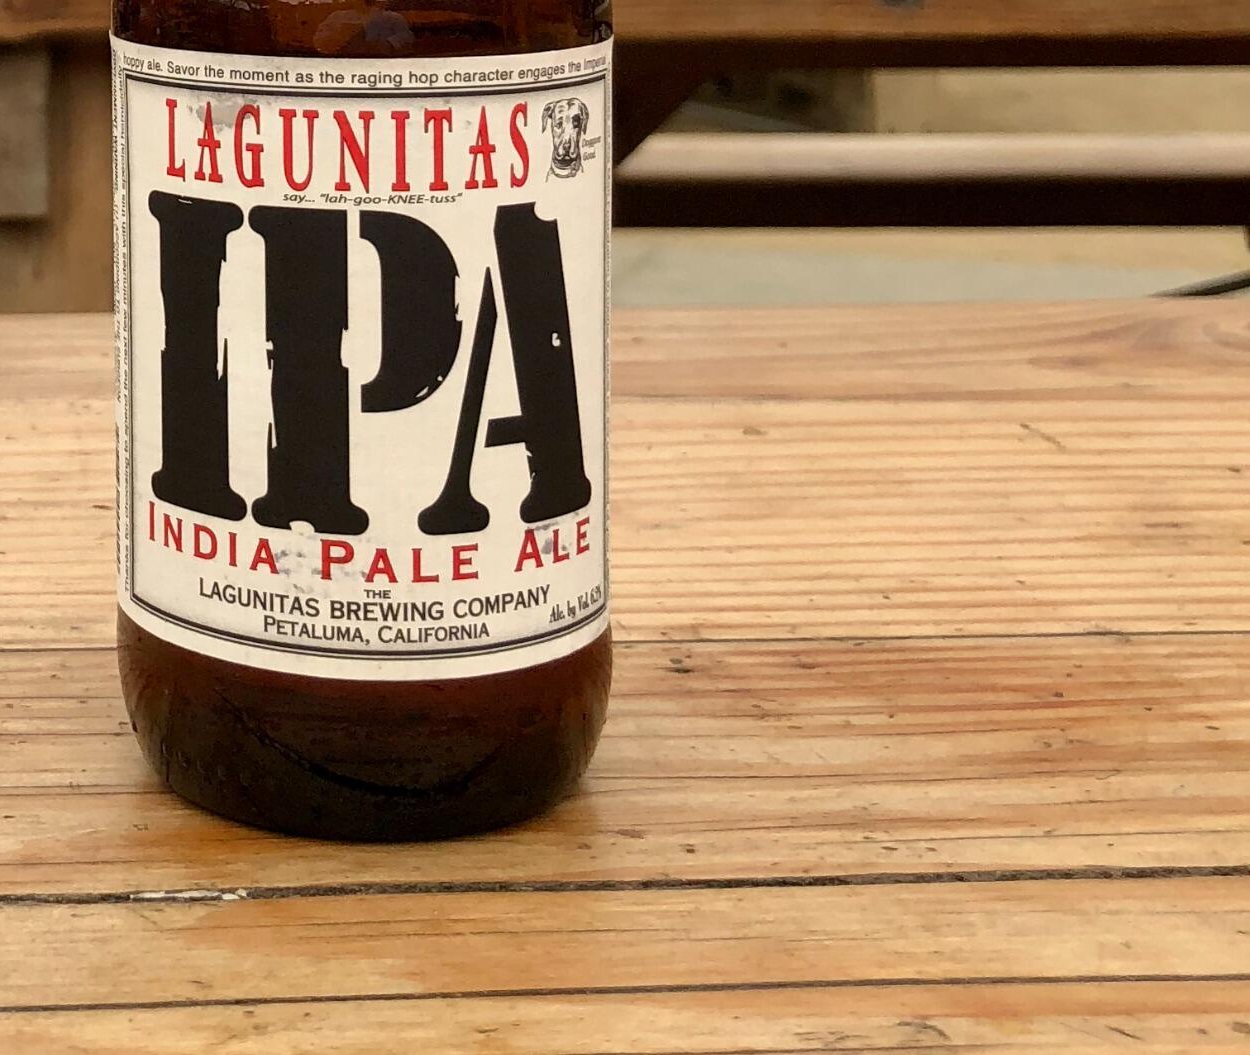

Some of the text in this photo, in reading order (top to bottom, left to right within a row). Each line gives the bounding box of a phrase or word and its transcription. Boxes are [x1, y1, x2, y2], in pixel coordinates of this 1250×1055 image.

[147, 58, 163, 72] ale.
[167, 61, 200, 76] Savor
[204, 65, 224, 78] the
[229, 66, 289, 82] moment
[295, 70, 314, 83] as
[319, 70, 345, 84] the
[351, 70, 403, 87] raging
[409, 70, 439, 87] hop
[444, 68, 514, 83] character
[518, 62, 566, 80] engages
[568, 61, 581, 74] the
[166, 98, 530, 194] LAGUNITAS
[283, 193, 315, 204] say...
[148, 190, 592, 535] IPA
[149, 500, 590, 583] INDIA PALE ALE
[199, 576, 550, 623] LAGUNITAS BREWING COMPANY
[363, 589, 391, 599] THE
[549, 603, 566, 623] Alc.
[567, 600, 576, 618] by
[264, 615, 490, 646] PETALUMA, CALIFORNIA
